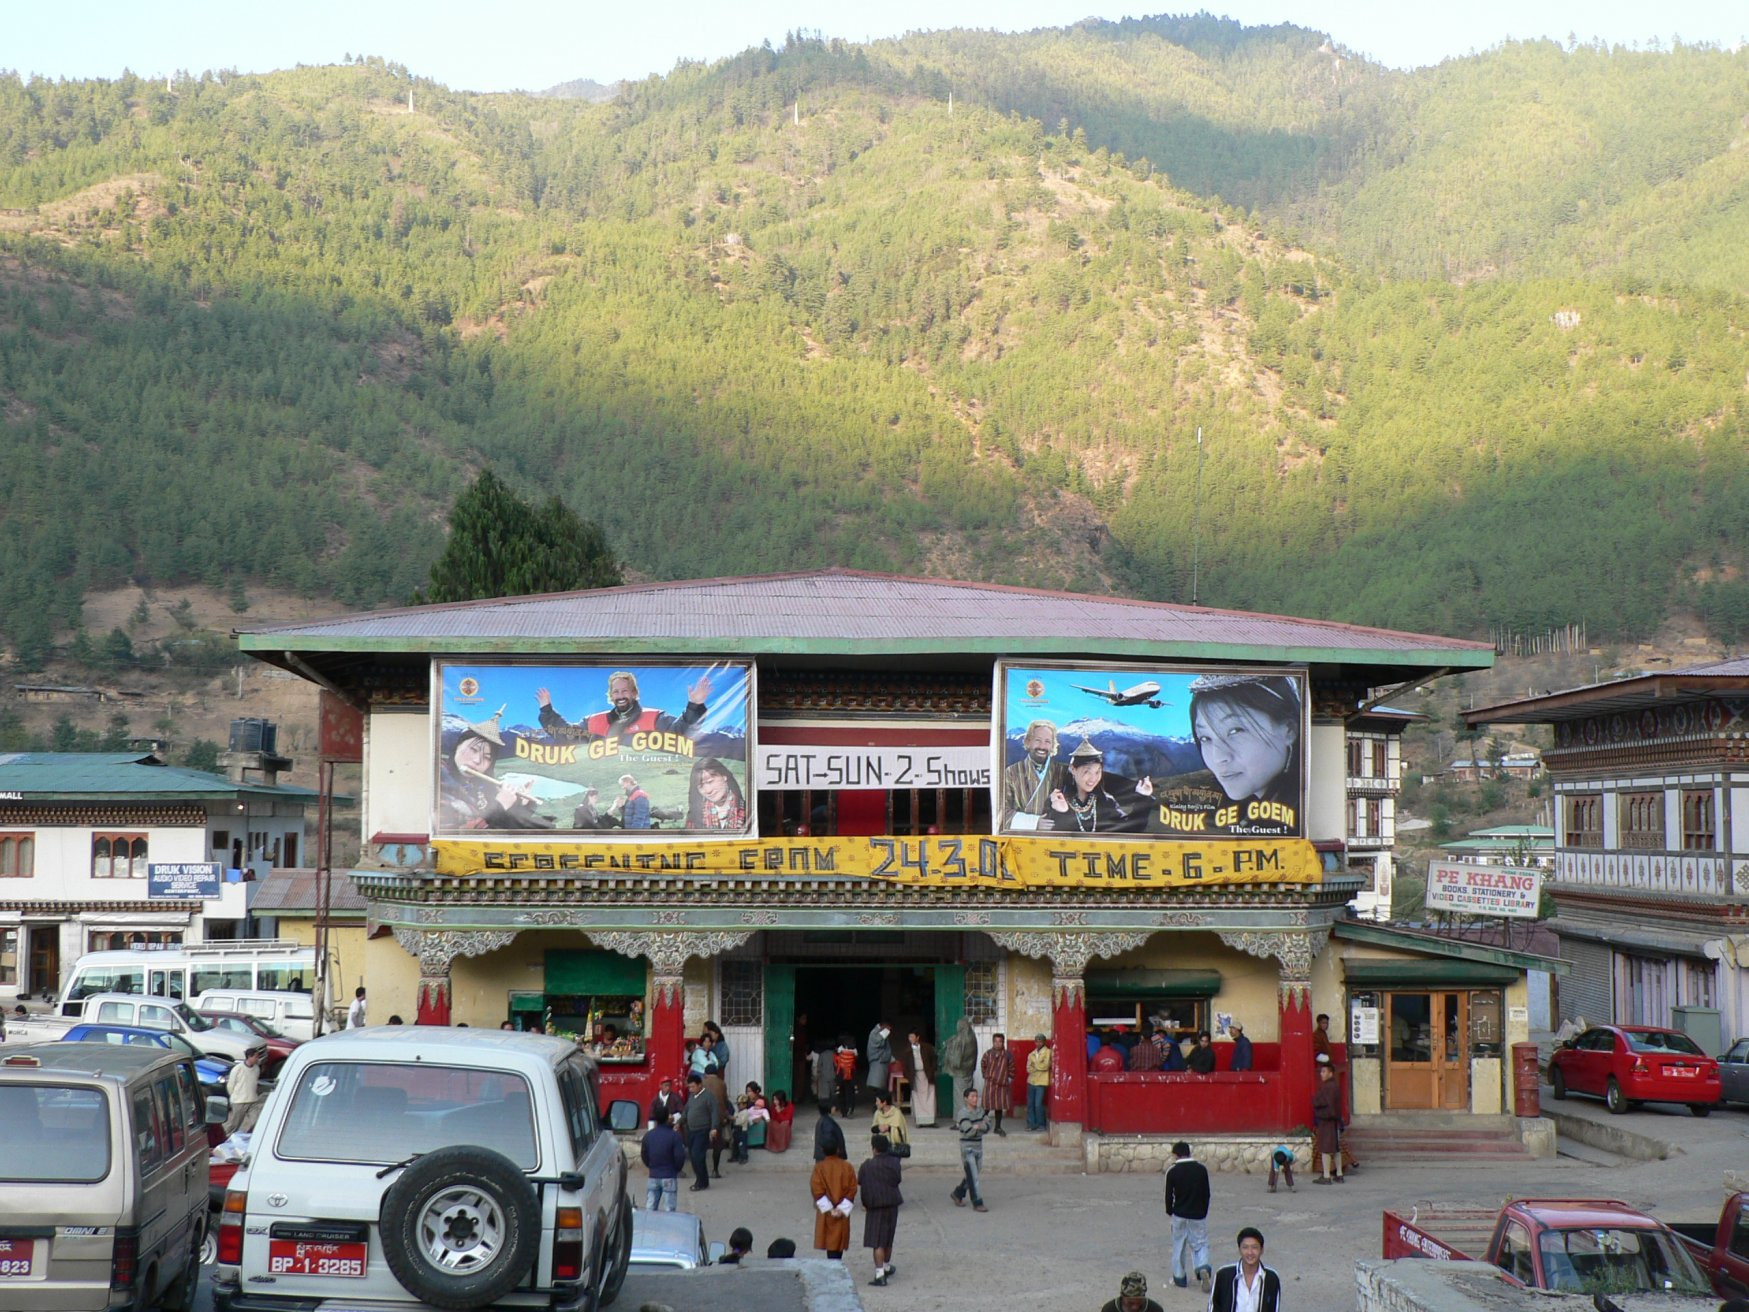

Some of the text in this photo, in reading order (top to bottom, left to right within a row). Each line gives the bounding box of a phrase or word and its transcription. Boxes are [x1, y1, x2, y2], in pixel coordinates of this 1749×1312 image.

[515, 731, 694, 765] DRUK GE GOEM
[619, 754, 639, 762] The
[1160, 801, 1295, 831] DRUK GE GOEM
[1229, 825, 1248, 834] The
[154, 865, 213, 874] DRUK VISION
[153, 874, 216, 882] AUDIO VIDEO REPAIR
[1436, 869, 1534, 891] PE KHANG
[171, 881, 197, 889] SERVICE
[1472, 887, 1517, 899] STATIONERY
[1432, 892, 1535, 909] VIDEO CASSETTES LIBRARY
[64, 1227, 96, 1235] OMNI
